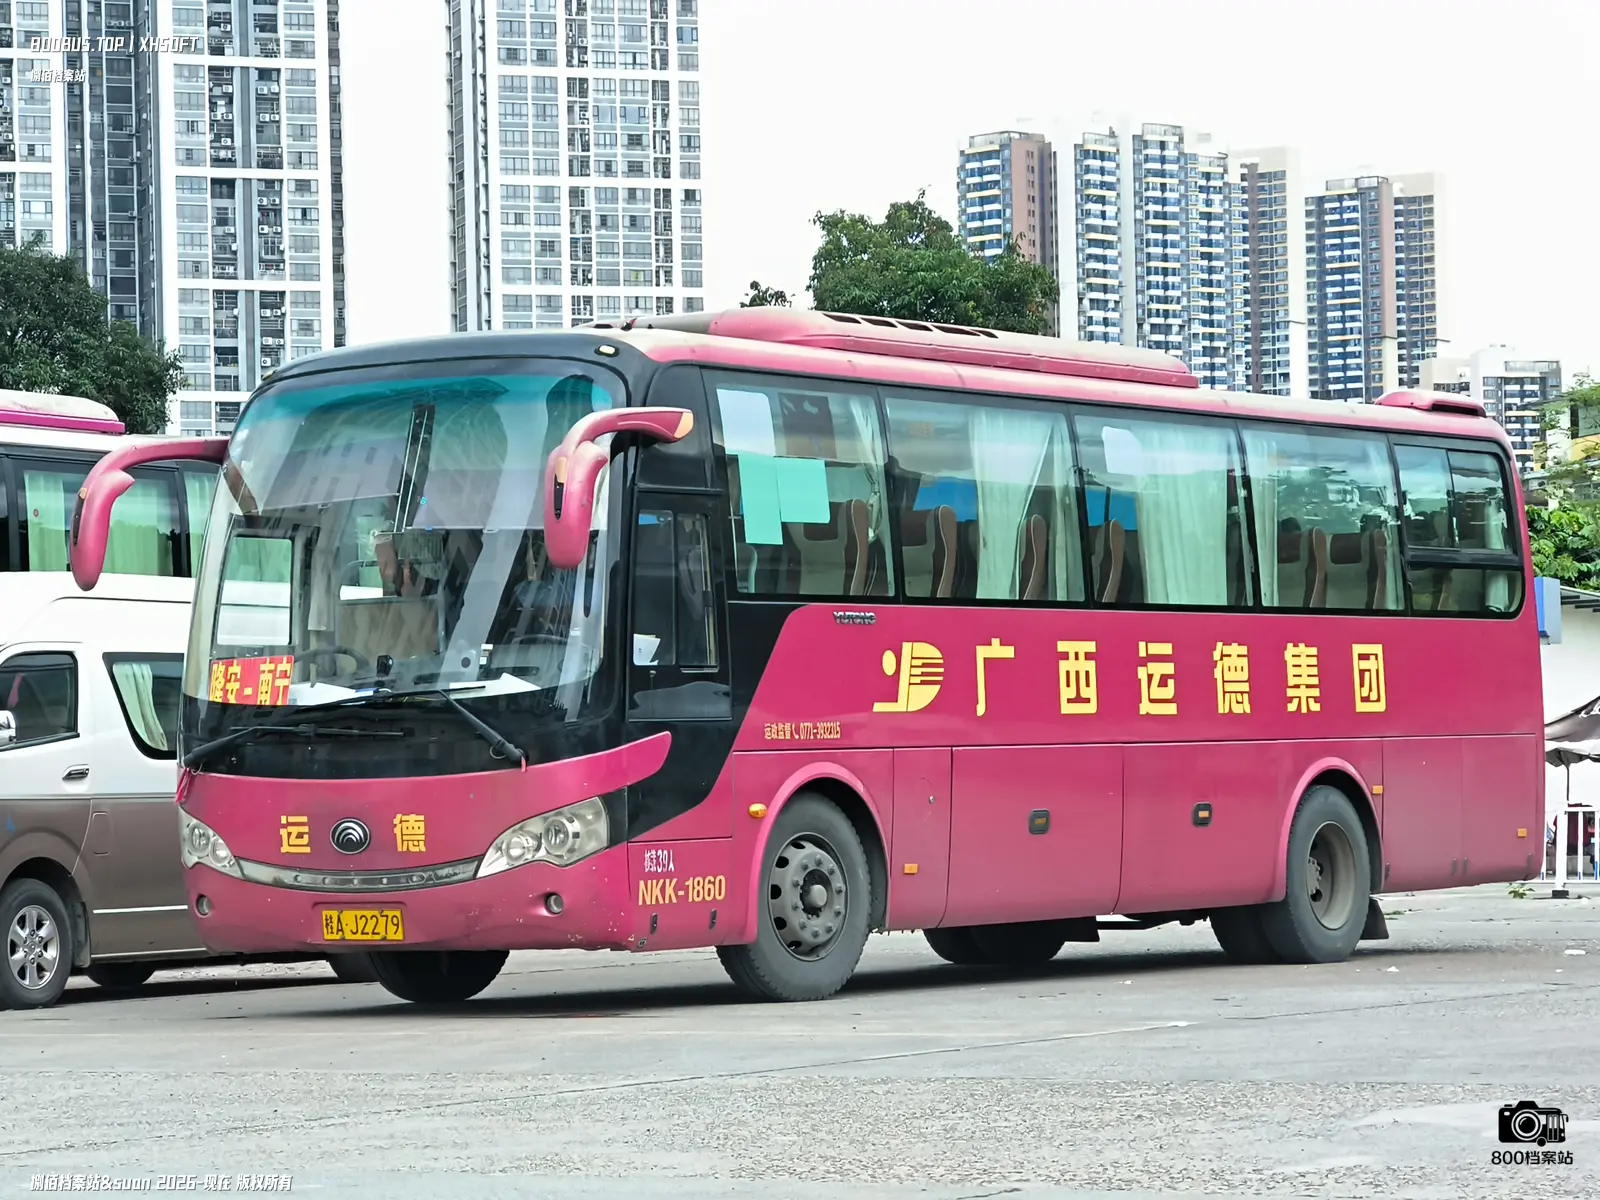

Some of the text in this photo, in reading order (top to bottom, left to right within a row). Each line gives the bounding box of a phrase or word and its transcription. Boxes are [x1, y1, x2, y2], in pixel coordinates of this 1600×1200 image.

[833, 611, 877, 624] YUTONG
[975, 638, 1386, 716] 广西运德集团
[279, 813, 426, 853] 运 德
[638, 875, 726, 906] NKK-1860
